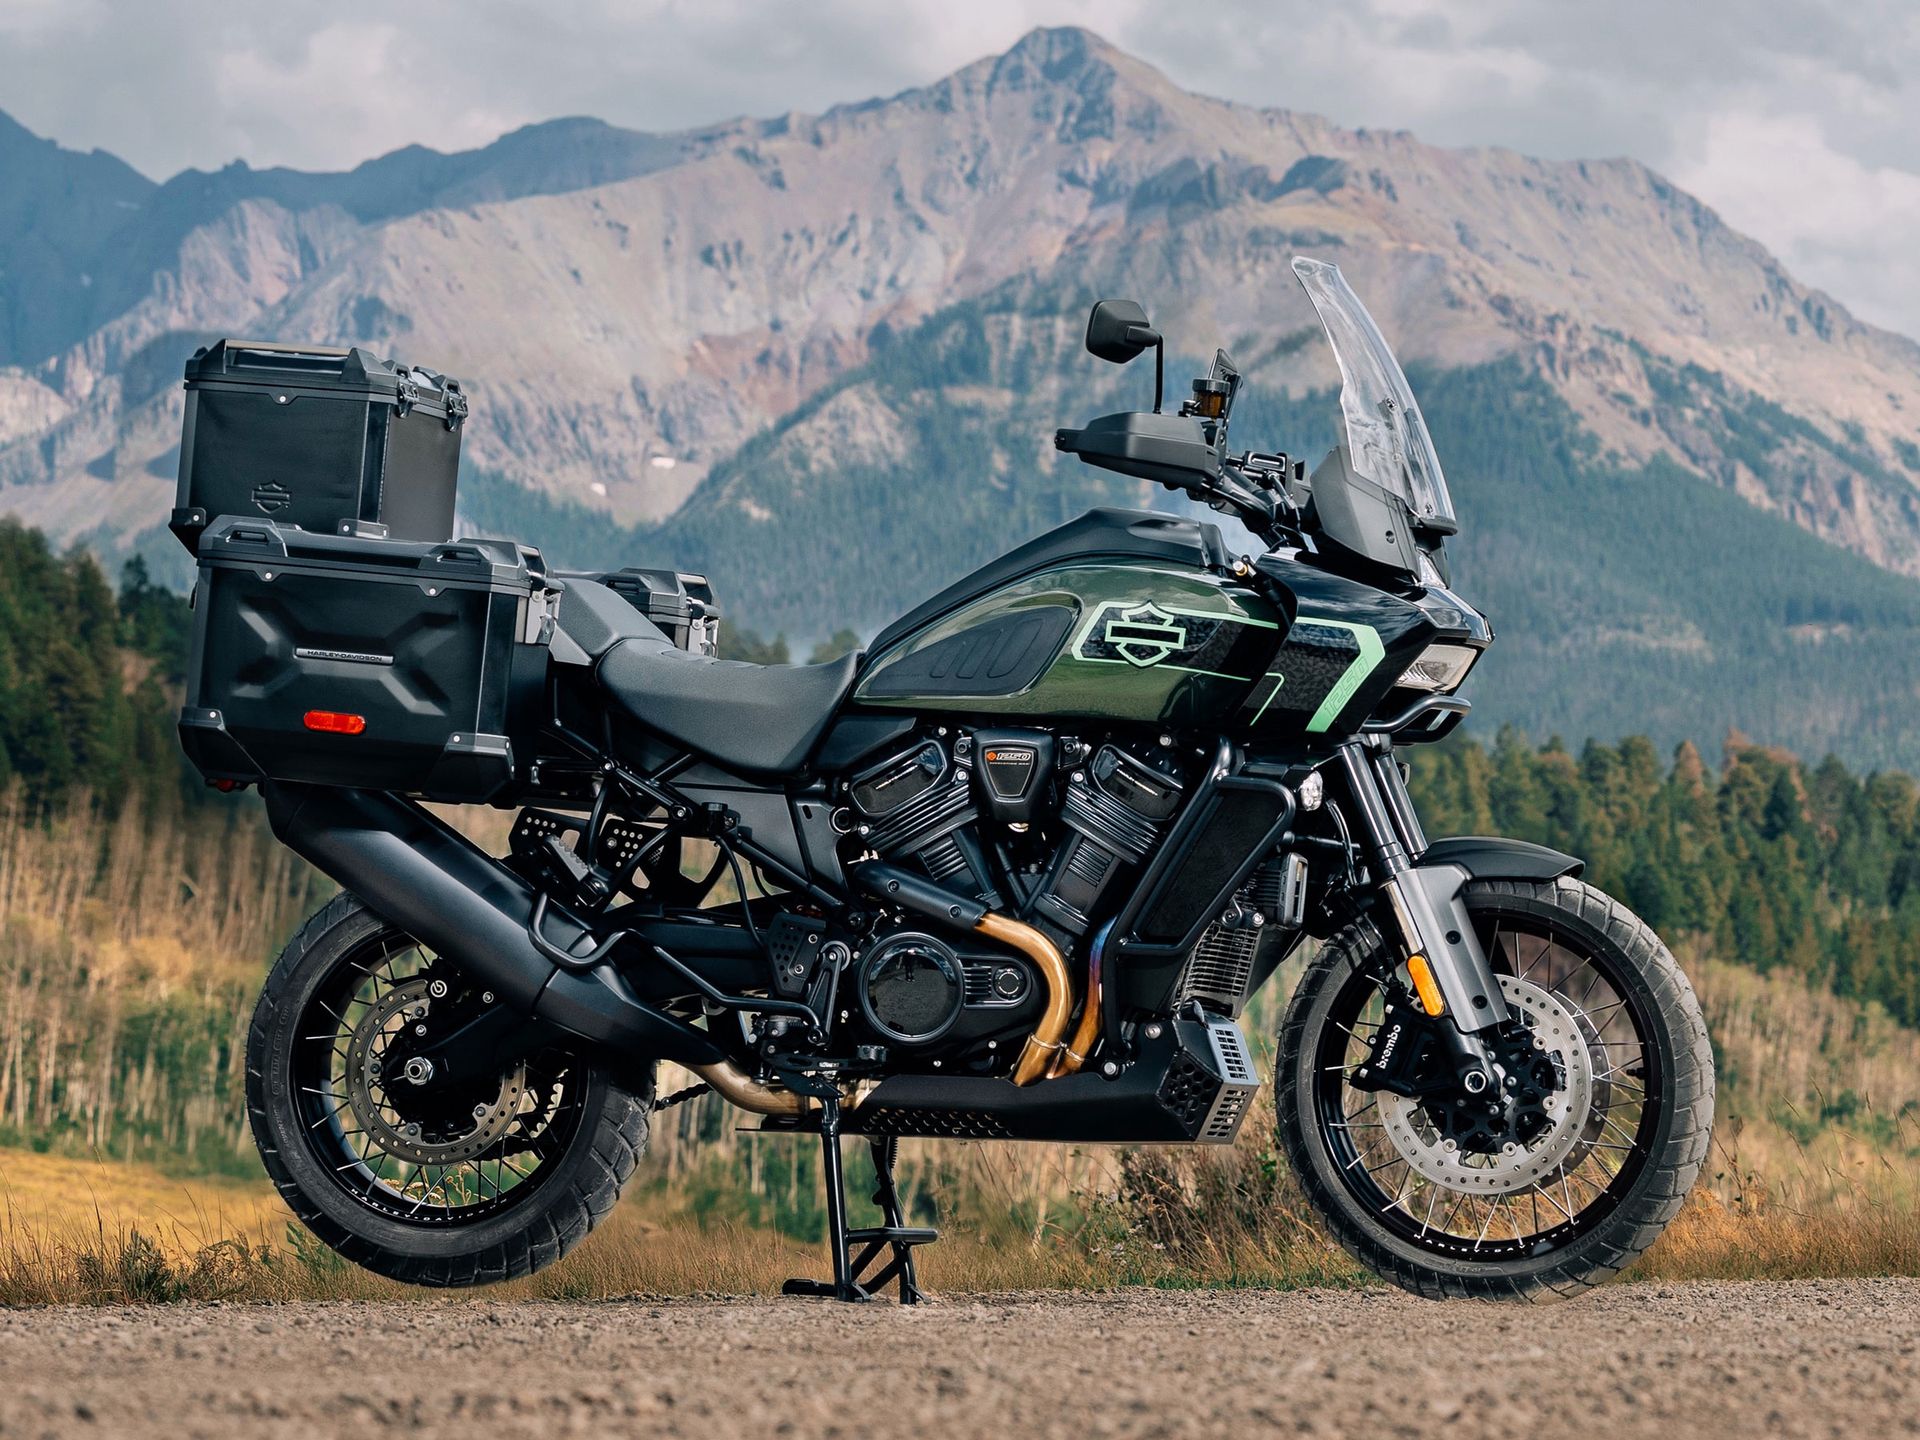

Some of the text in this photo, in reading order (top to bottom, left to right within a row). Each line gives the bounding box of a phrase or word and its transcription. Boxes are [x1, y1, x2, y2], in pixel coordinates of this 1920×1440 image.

[307, 650, 383, 662] HARLEY-DAVIDSON
[1323, 655, 1370, 718] 1250
[1375, 1024, 1402, 1070] brembo
